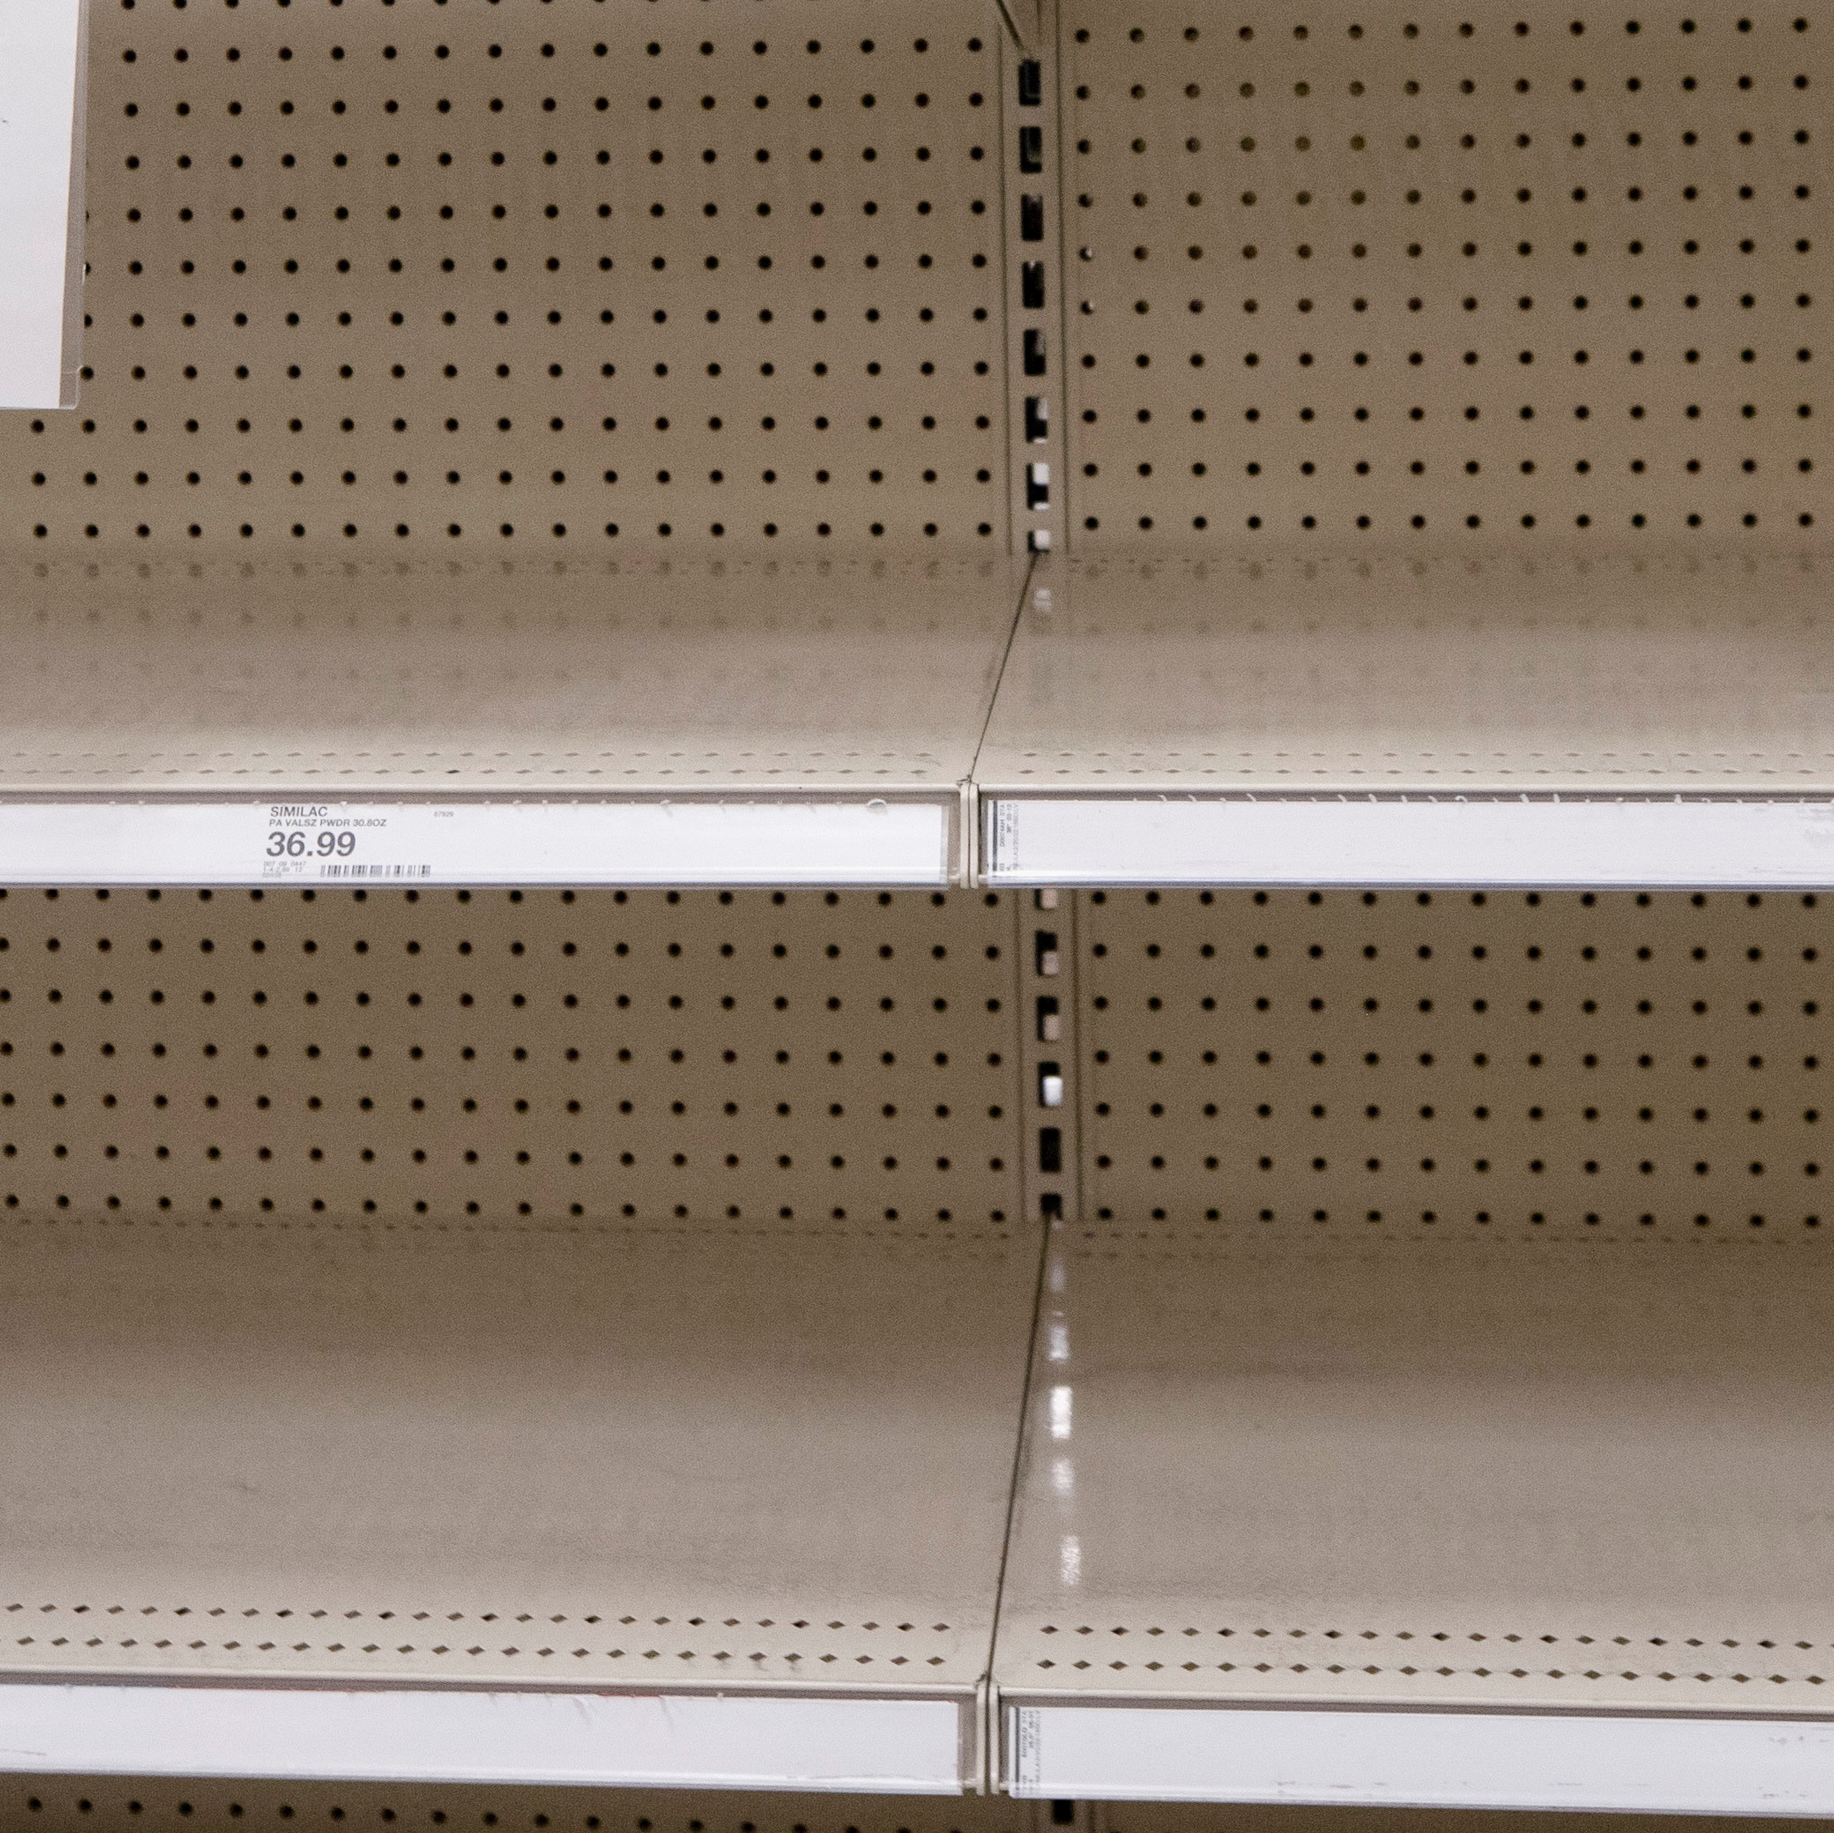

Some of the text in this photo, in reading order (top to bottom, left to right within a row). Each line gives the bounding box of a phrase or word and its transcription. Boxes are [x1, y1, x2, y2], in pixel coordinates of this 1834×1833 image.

[271, 806, 327, 817] SIMILAC
[269, 819, 282, 827] PA
[319, 819, 351, 827] PWDR
[267, 832, 356, 856] 36.99
